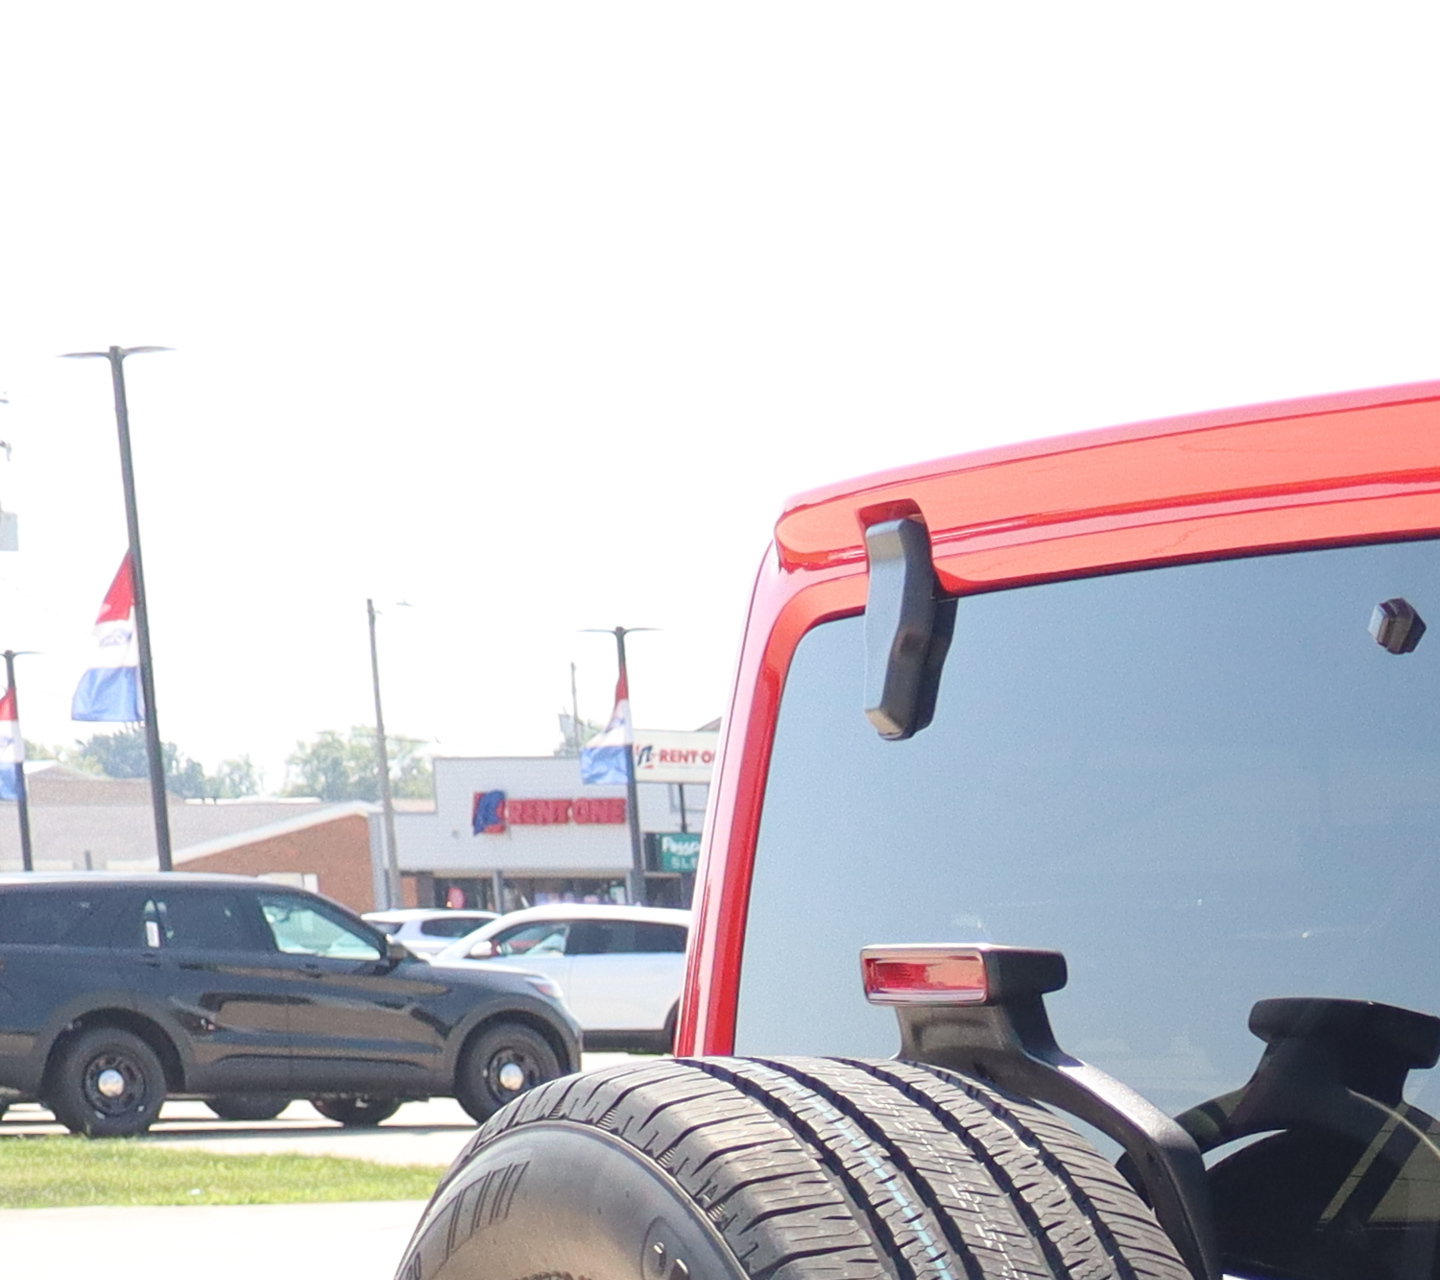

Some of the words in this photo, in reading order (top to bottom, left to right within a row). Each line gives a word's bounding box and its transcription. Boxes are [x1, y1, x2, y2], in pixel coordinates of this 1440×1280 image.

[659, 749, 697, 764] RENT
[508, 798, 572, 825] RENT
[573, 798, 626, 825] ONE
